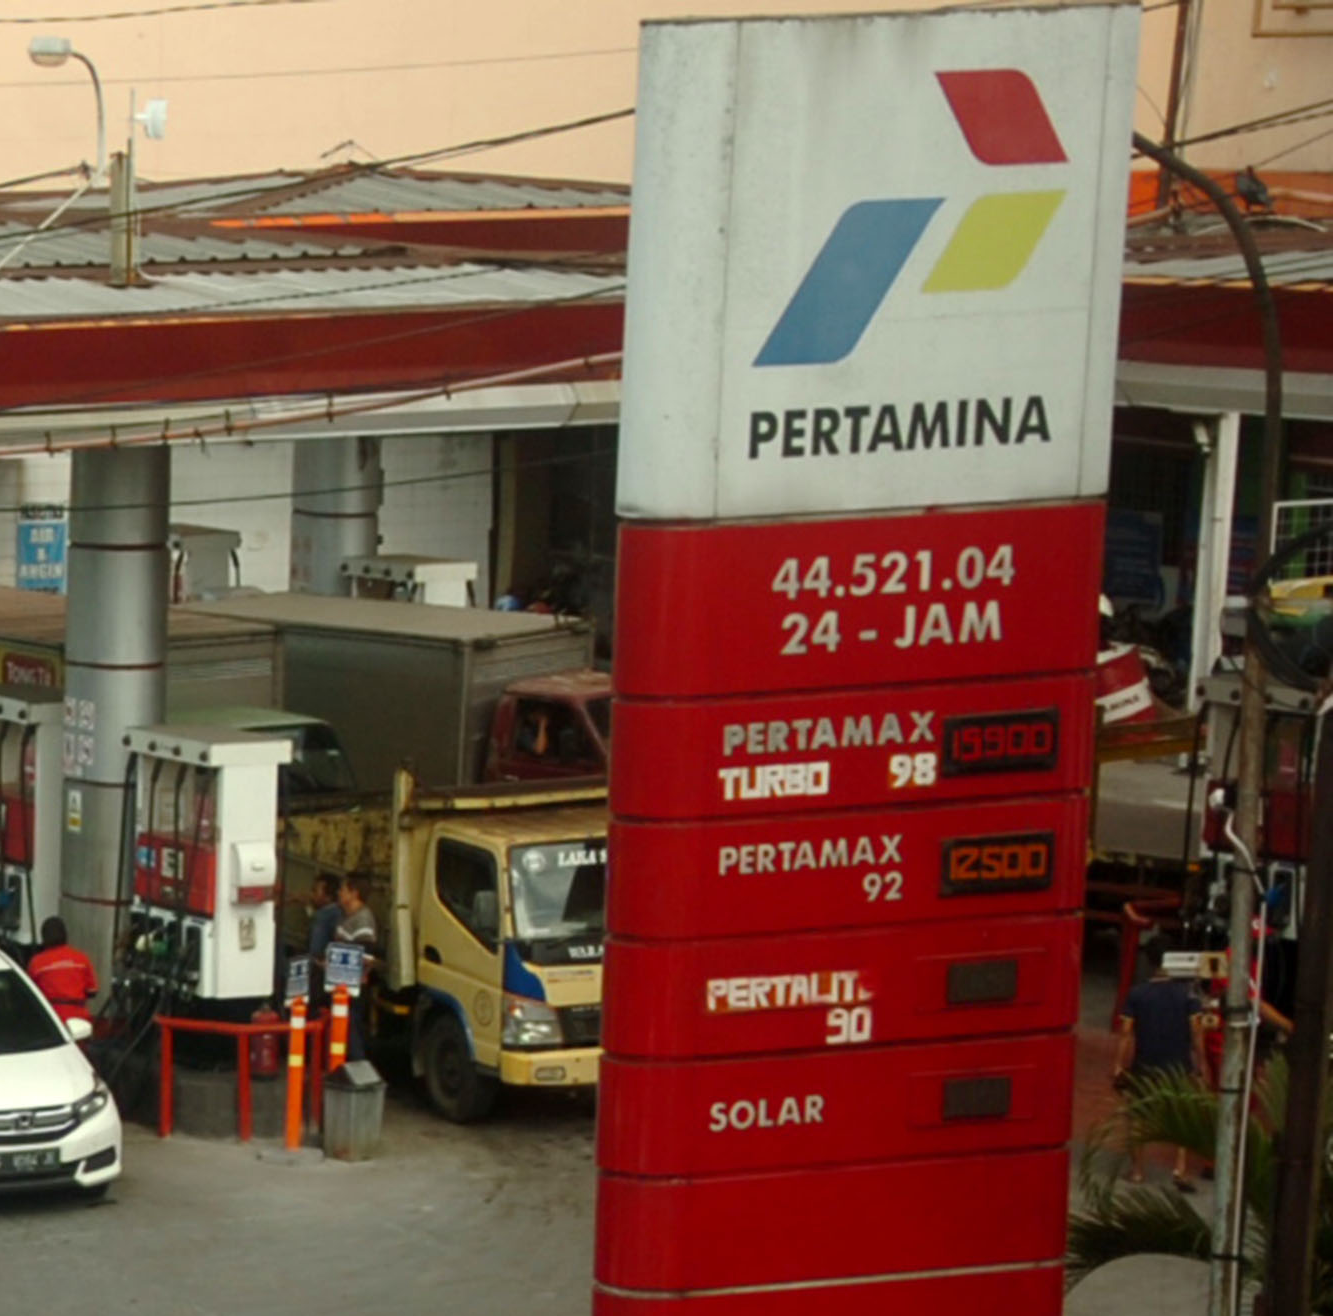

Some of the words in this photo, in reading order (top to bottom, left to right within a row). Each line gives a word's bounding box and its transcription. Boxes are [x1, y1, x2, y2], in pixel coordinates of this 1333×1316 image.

[748, 396, 1052, 459] PERTAMINA
[771, 544, 1016, 600] 44.521.04
[780, 610, 842, 656] 24
[858, 631, 879, 642] -
[893, 600, 1003, 650] JAM
[722, 711, 936, 756] PERTAMAX
[952, 723, 1053, 763] 15900
[718, 761, 831, 801] TURBO
[889, 752, 938, 788] 98
[718, 834, 903, 876] PERTAMAX
[949, 844, 1048, 880] 12500
[862, 871, 904, 902] 92
[707, 970, 874, 1012] PERTALIT
[825, 1007, 872, 1045] 90
[708, 1094, 825, 1132] SOLAR
